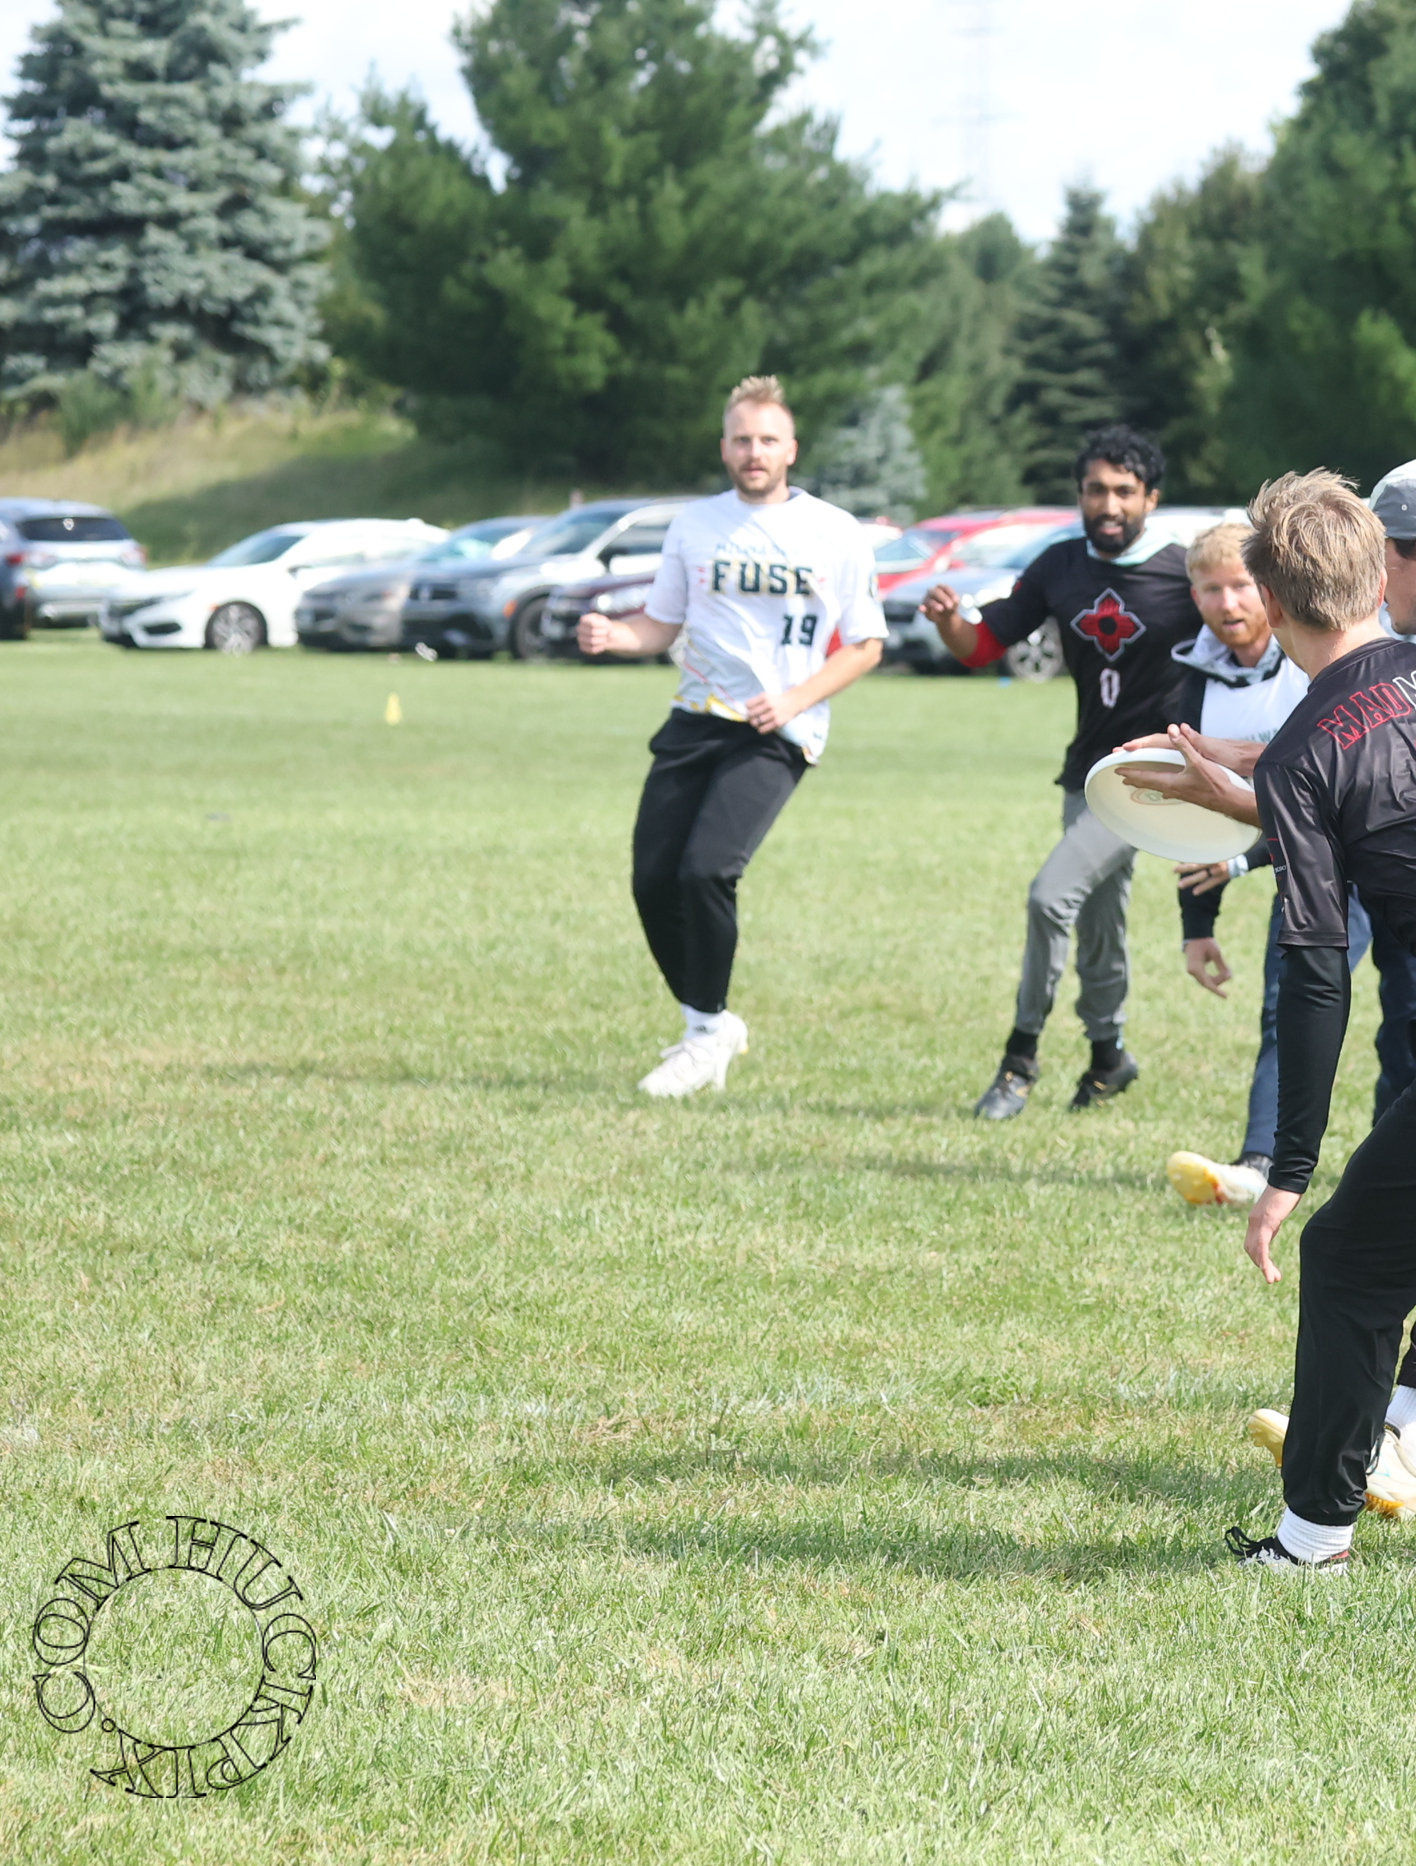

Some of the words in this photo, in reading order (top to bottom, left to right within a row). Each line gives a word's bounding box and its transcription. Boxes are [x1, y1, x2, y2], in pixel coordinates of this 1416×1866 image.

[711, 559, 813, 596] FUSE
[781, 614, 818, 646] 19
[1100, 667, 1120, 708] 0
